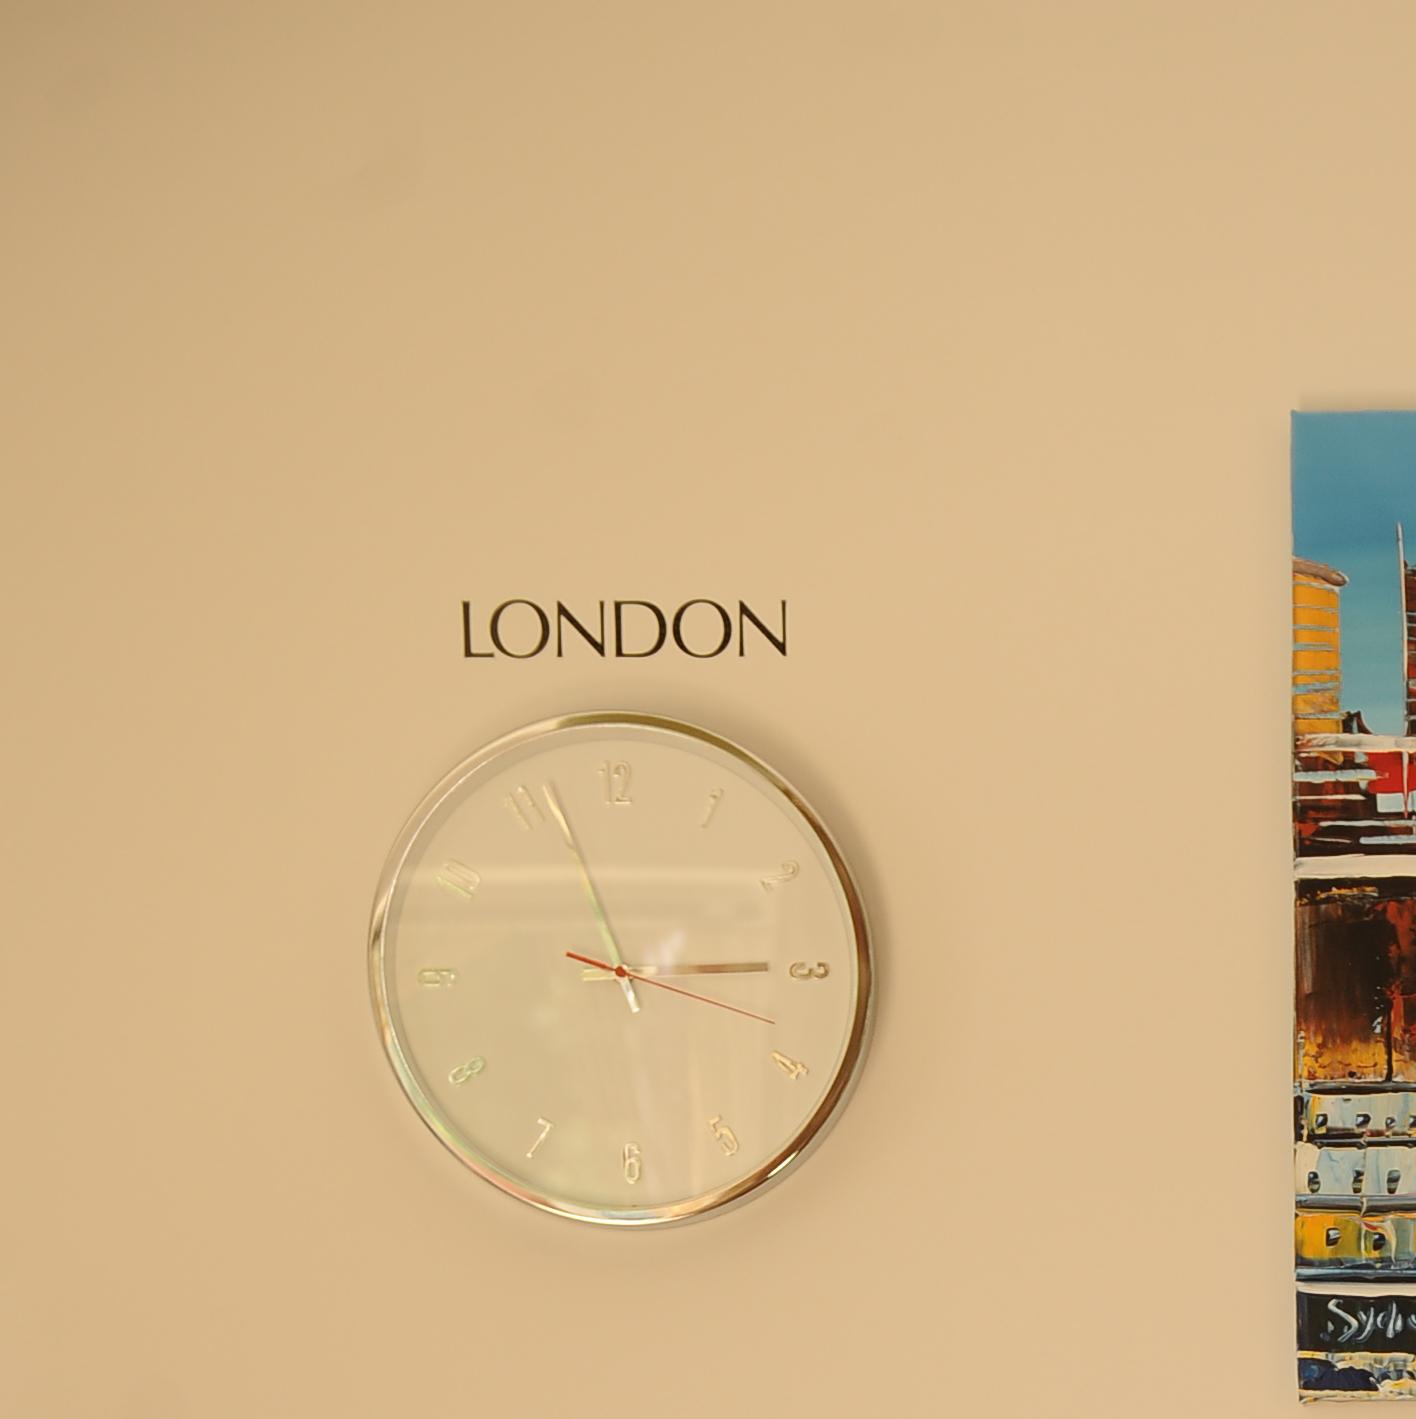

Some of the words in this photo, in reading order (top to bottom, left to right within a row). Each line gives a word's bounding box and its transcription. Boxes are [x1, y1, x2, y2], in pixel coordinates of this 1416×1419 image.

[461, 599, 788, 659] LONDON
[597, 760, 633, 805] 12
[504, 785, 546, 830] 11
[701, 787, 724, 828] 1
[436, 858, 481, 898] 10
[760, 860, 799, 892] 2
[417, 967, 458, 988] 9
[789, 961, 829, 981] 3
[447, 1056, 487, 1086] 8
[771, 1050, 809, 1080] 4
[526, 1117, 554, 1158] 7
[709, 1114, 740, 1156] 5
[622, 1142, 642, 1185] 6
